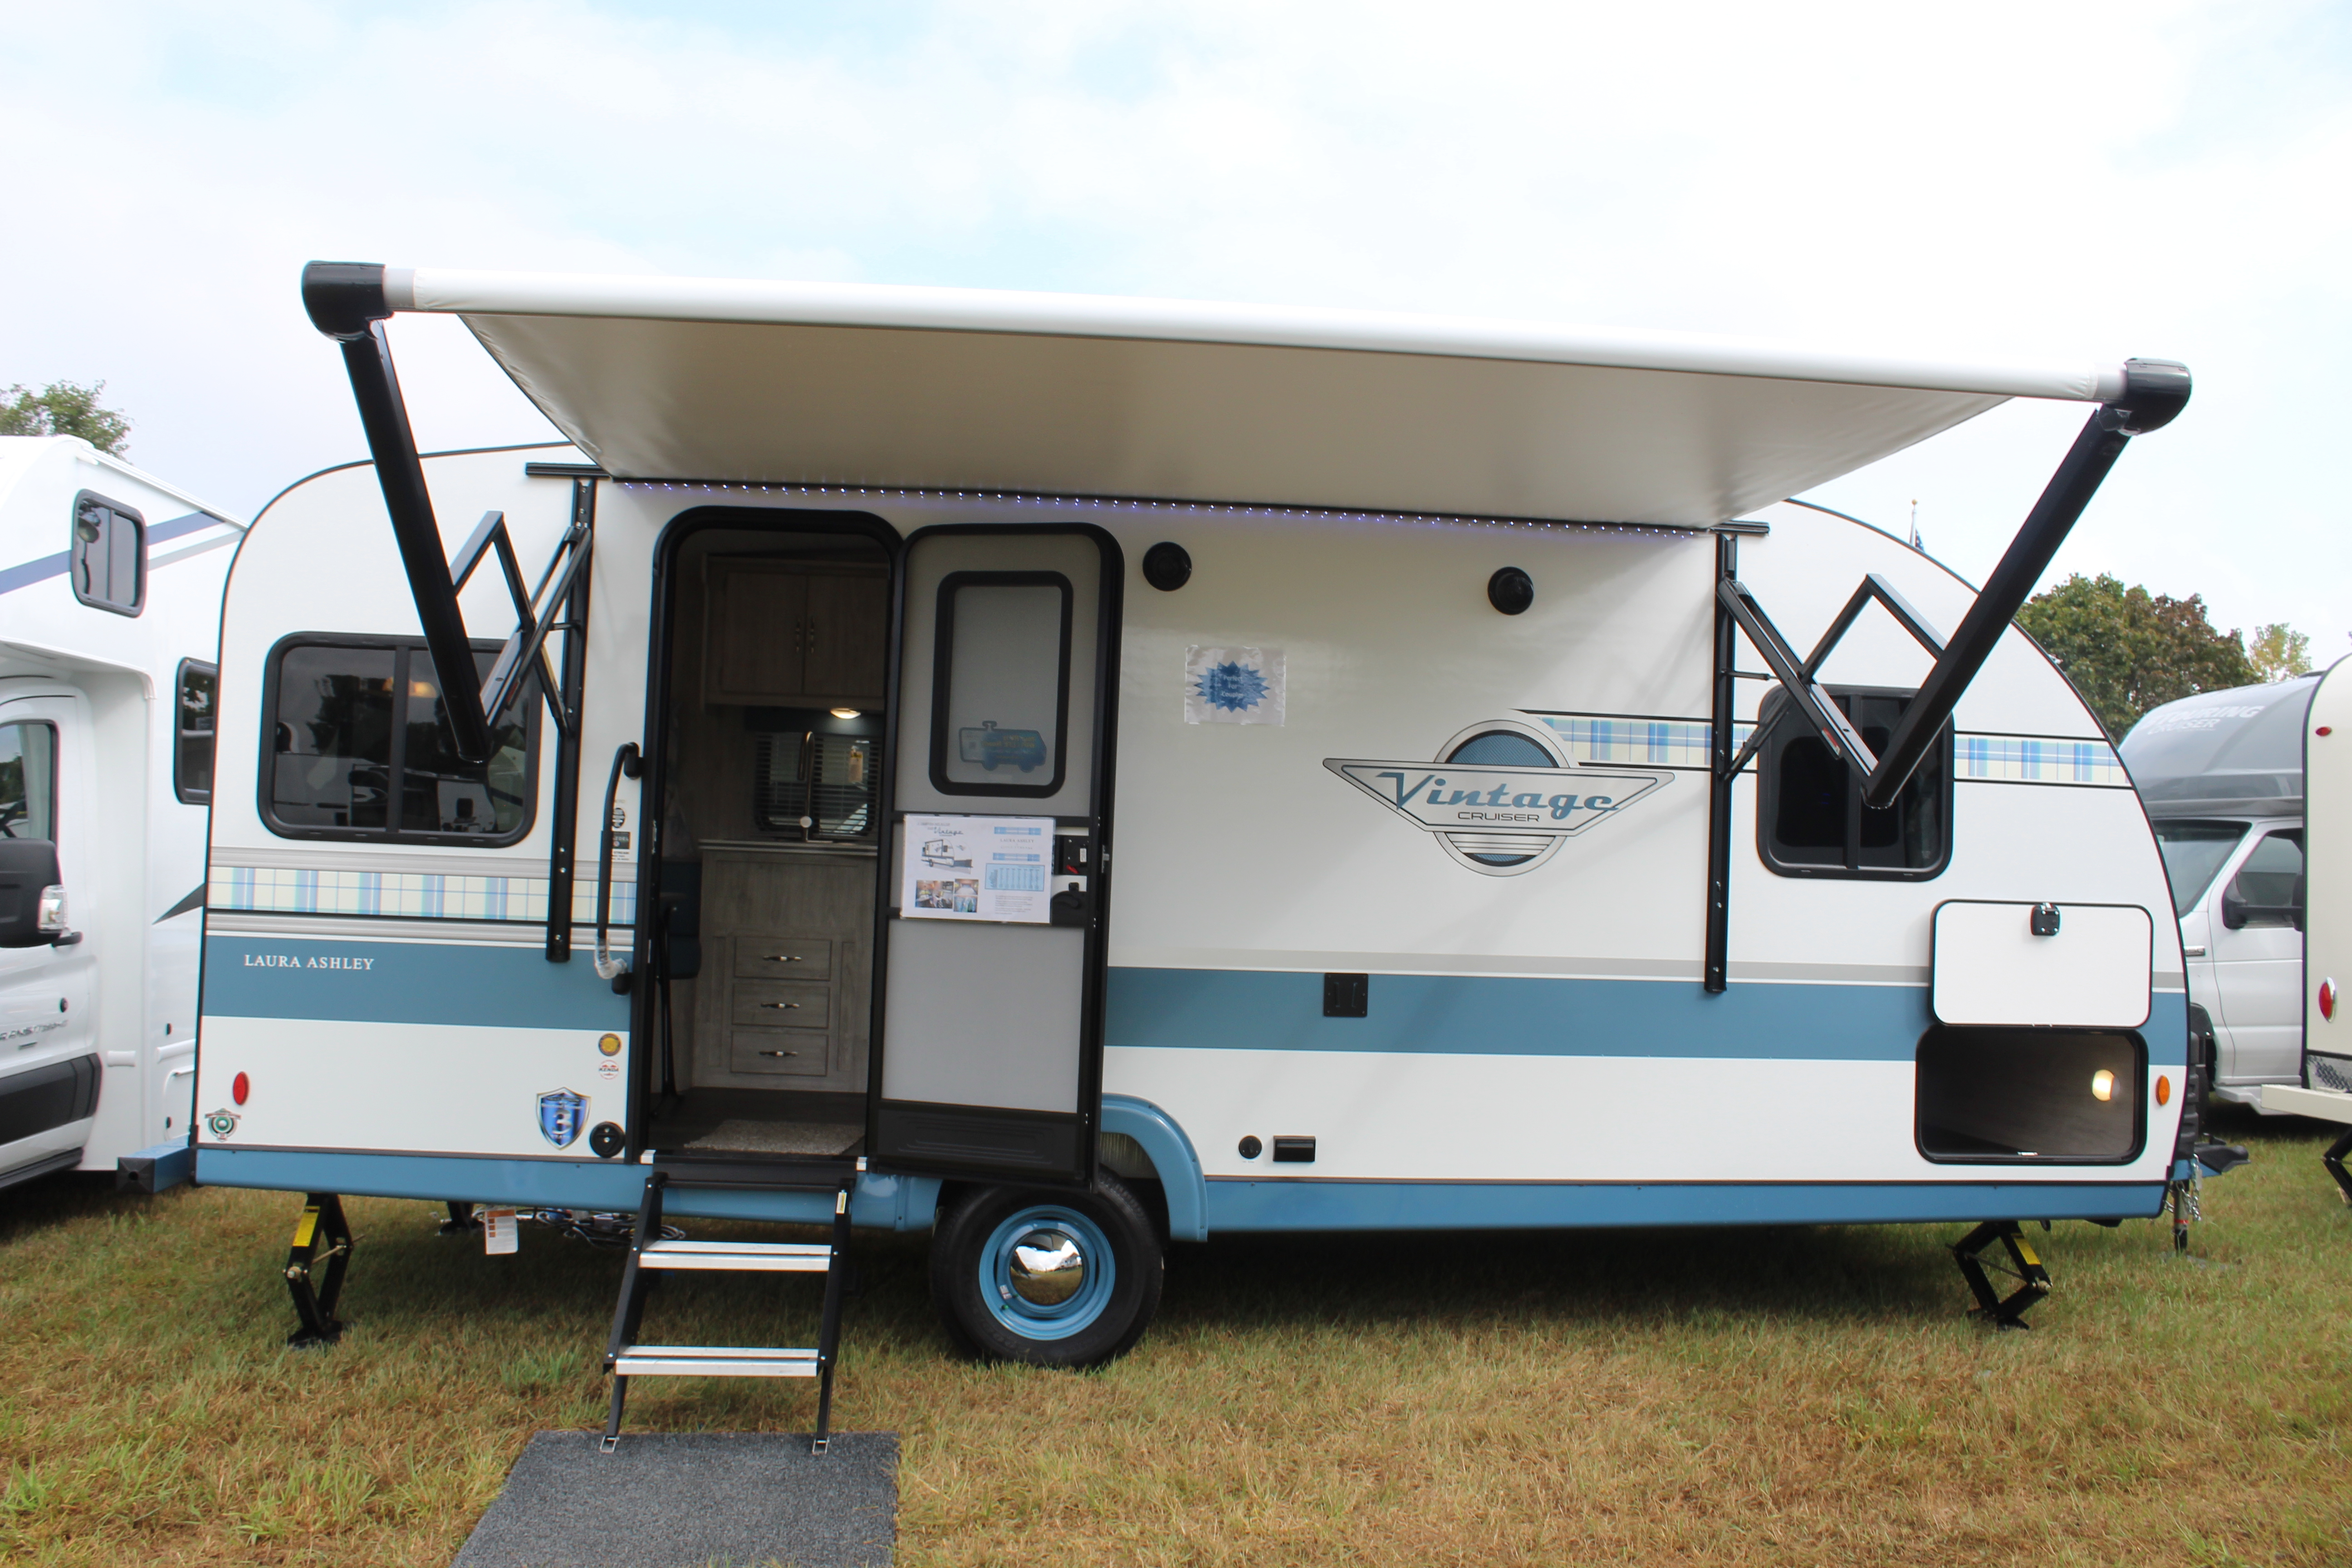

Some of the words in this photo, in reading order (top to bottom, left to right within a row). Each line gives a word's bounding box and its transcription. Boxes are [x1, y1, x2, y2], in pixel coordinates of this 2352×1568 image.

[1376, 772, 1619, 819] Vintage
[1457, 811, 1540, 823] CRUISER
[244, 954, 302, 968] LAURA
[306, 956, 375, 970] ASHLEY
[552, 1109, 573, 1135] 3
